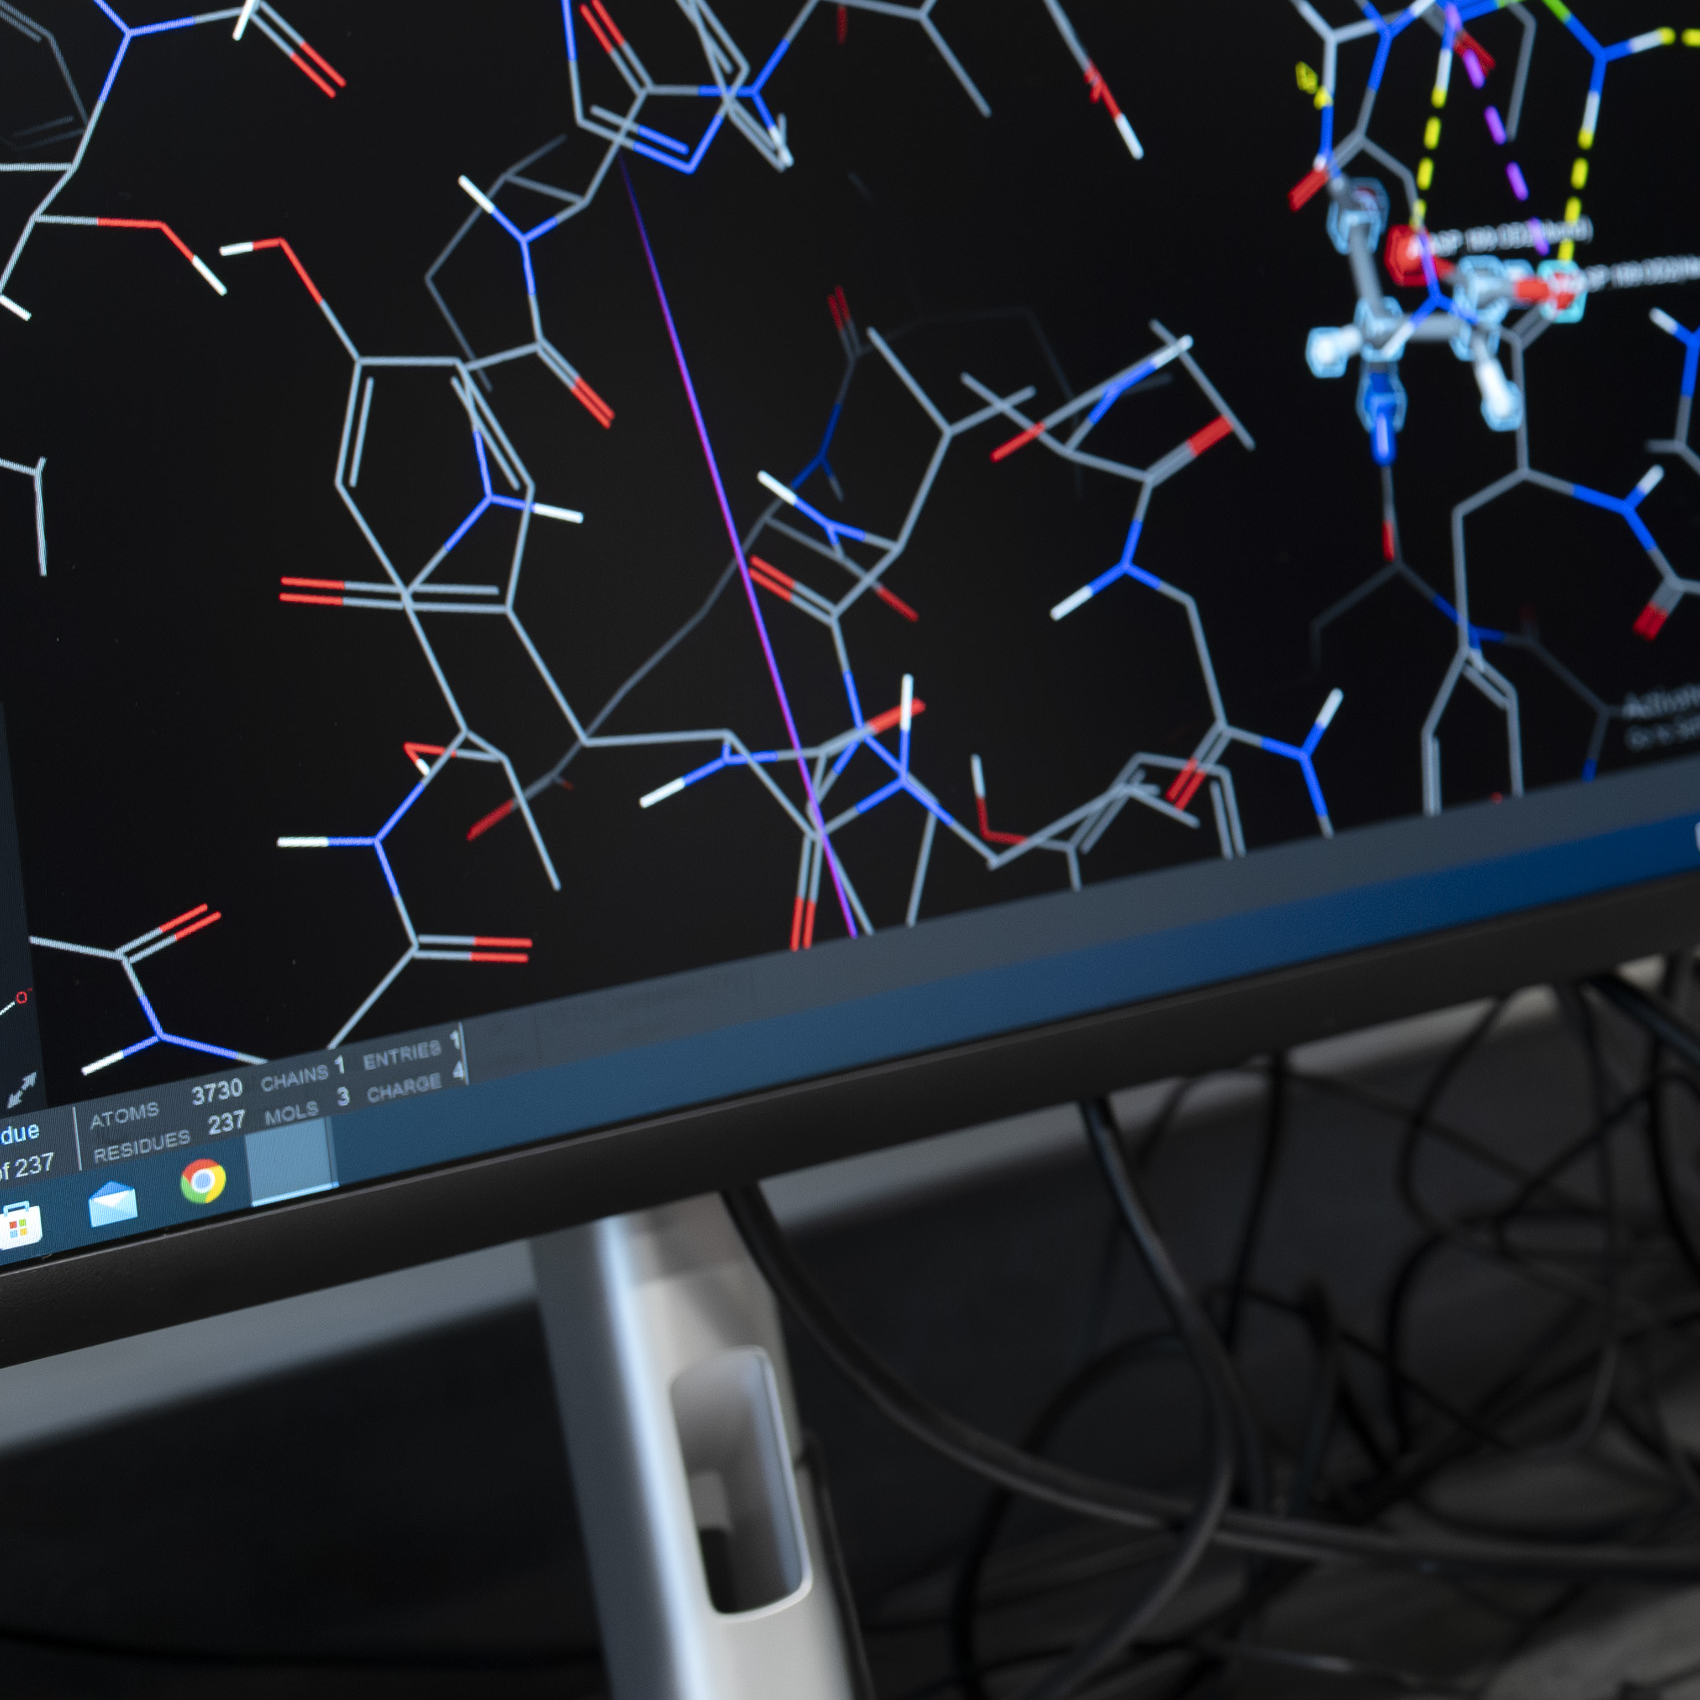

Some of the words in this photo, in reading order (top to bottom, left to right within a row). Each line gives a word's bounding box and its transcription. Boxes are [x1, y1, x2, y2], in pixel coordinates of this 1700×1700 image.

[363, 1039, 442, 1071] ENTRIES
[450, 1029, 461, 1050] 1
[261, 1064, 329, 1093] CHAINS
[334, 1055, 345, 1074] 1
[367, 1072, 442, 1104] CHARGE
[90, 1102, 160, 1131] ATOMS
[191, 1077, 244, 1106] 3730
[264, 1101, 320, 1127] MOLS
[336, 1087, 350, 1107] 3
[94, 1129, 191, 1164] RESIDUES
[208, 1109, 246, 1136] 237
[14, 1151, 55, 1179] 237
